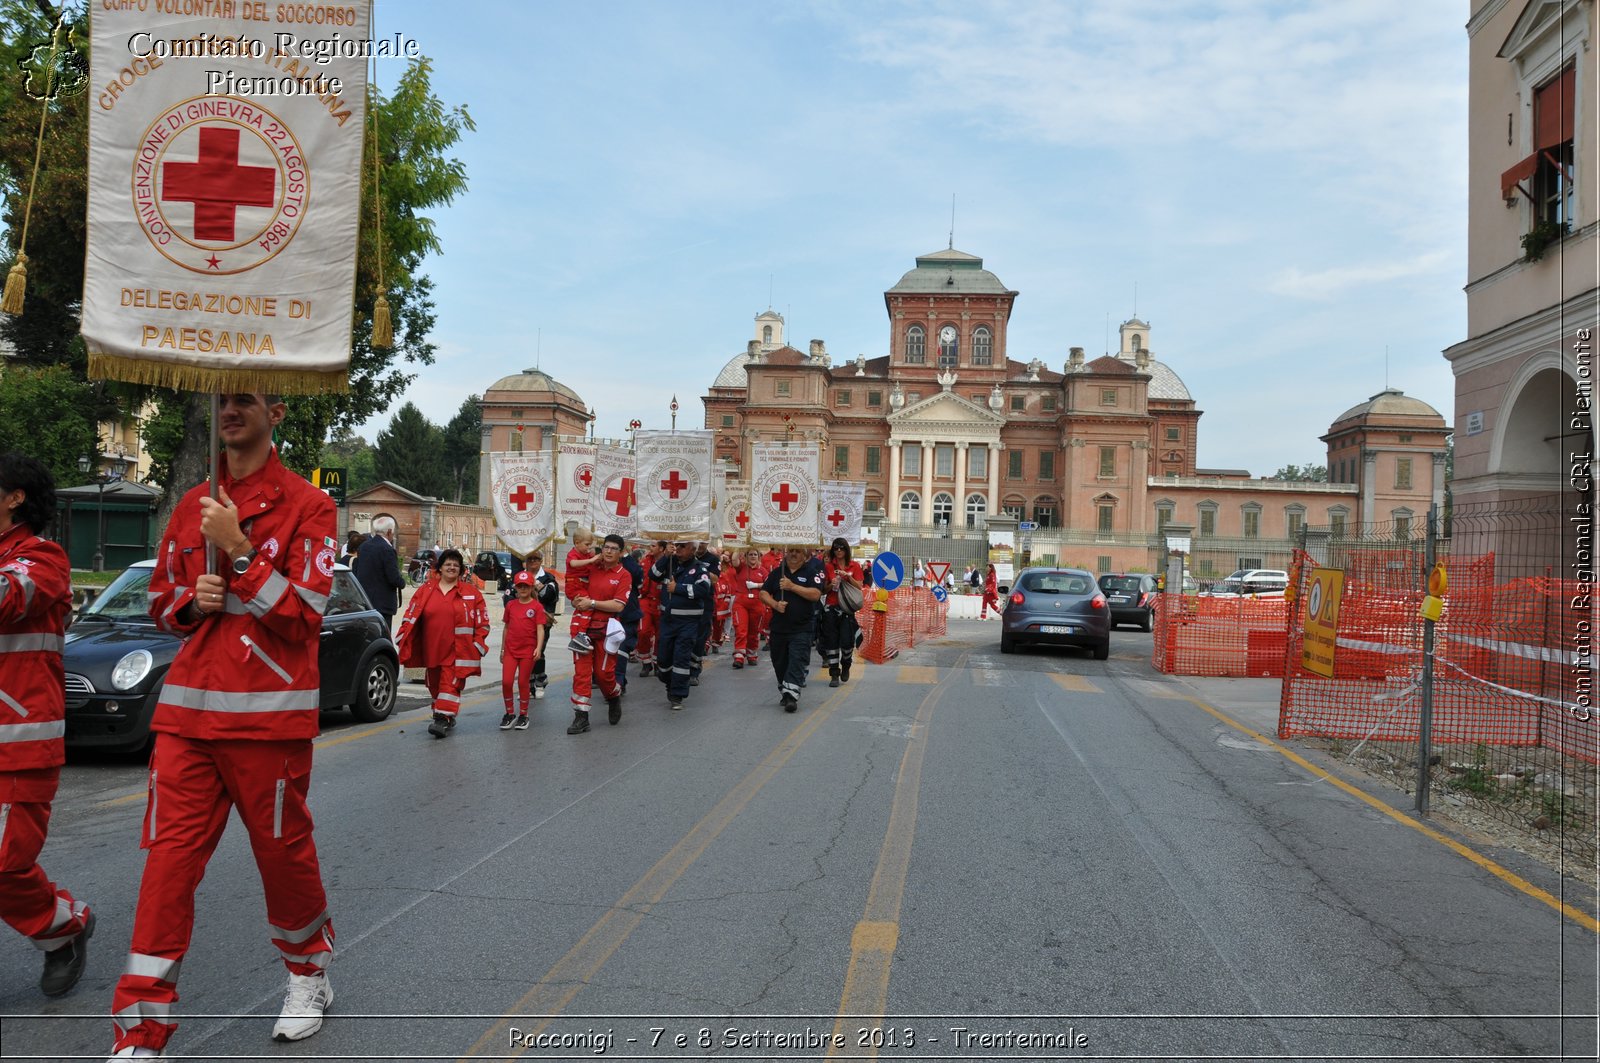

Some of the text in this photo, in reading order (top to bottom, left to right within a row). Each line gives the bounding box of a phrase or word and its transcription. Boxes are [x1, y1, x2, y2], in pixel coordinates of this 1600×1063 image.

[103, 0, 356, 26] CORPO VOLONTARI DEL SOCCORSO
[99, 51, 164, 110] CROCE
[136, 101, 304, 252] CONVENZIONE DI GINEVRA 22 AGOSTO 1864
[120, 287, 311, 319] DELEGAZIONE DI
[142, 325, 275, 355] PAESANA
[505, 466, 529, 475] ROSSA
[769, 463, 794, 473] ROSSA
[795, 465, 817, 494] ITALIANA
[500, 528, 547, 537] SAVIGLIANO
[644, 515, 673, 523] COMITATO
